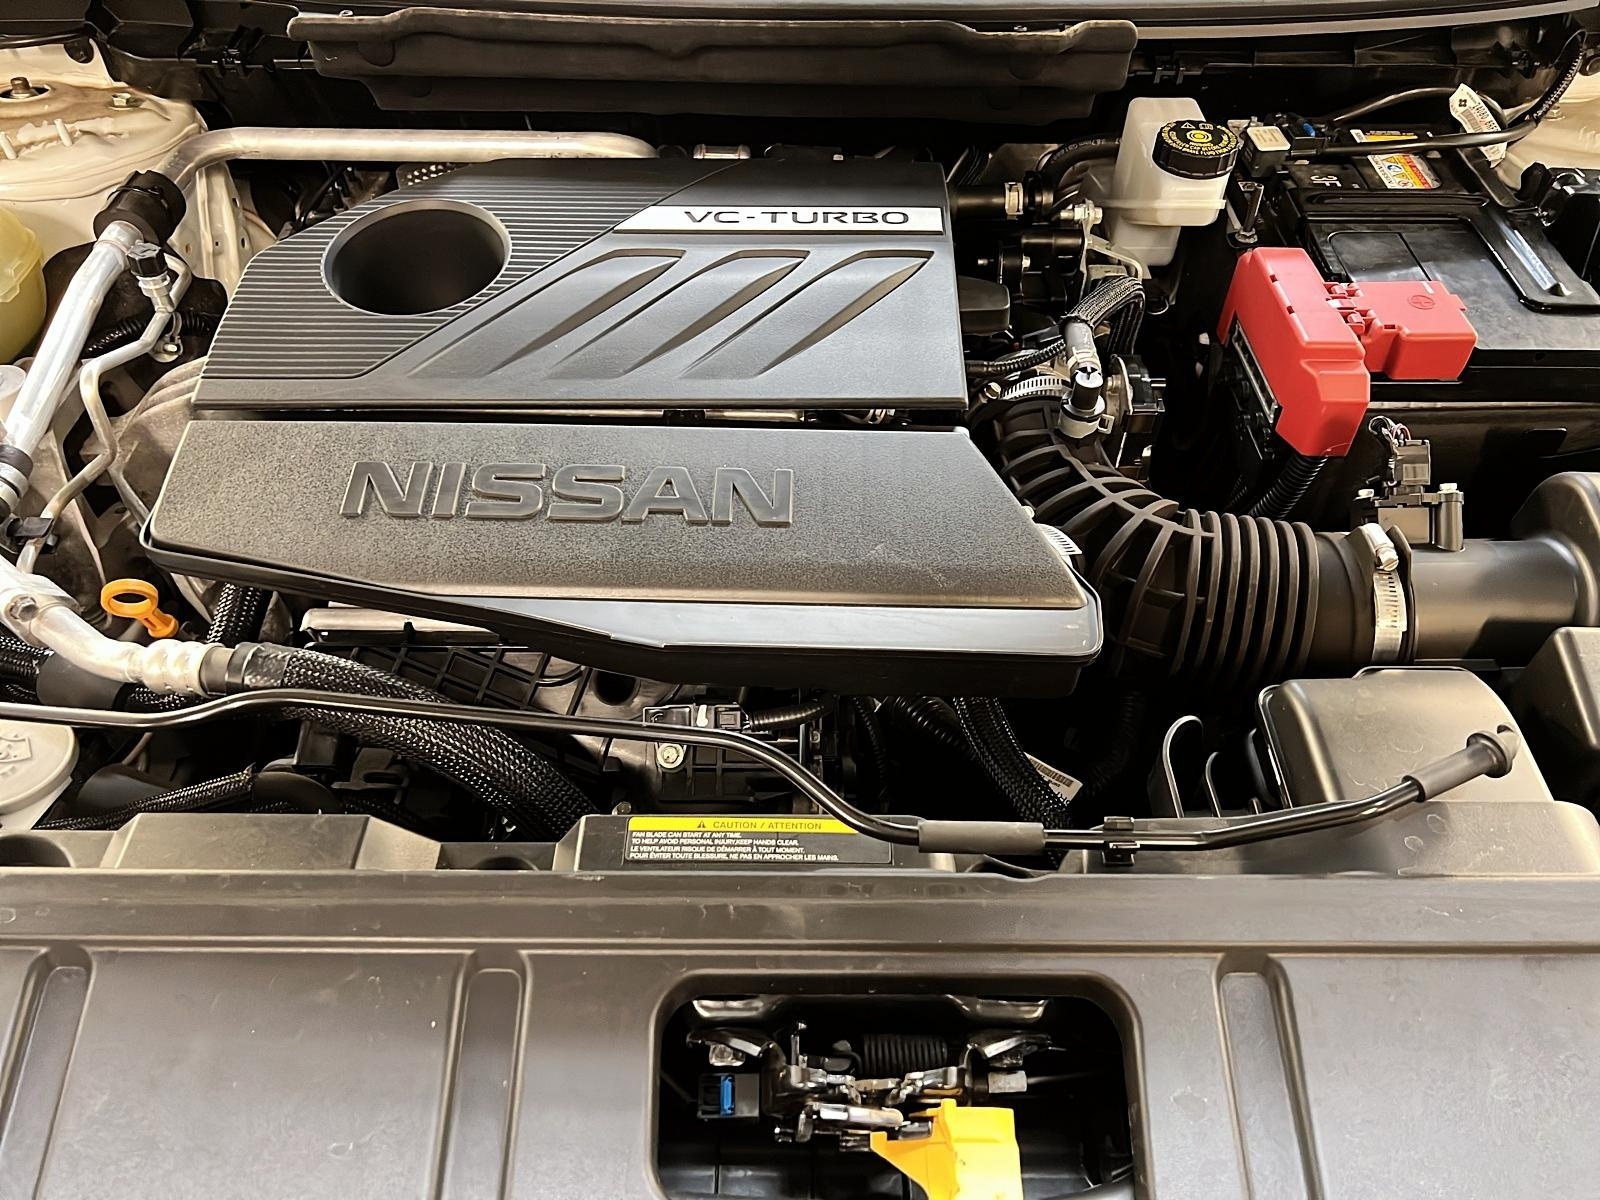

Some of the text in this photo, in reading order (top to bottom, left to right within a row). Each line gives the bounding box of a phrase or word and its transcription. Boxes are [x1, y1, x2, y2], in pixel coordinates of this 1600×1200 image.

[684, 211, 909, 224] VC-TURBO
[338, 461, 795, 528] NISSAN
[713, 821, 757, 829] CAUTION
[768, 822, 822, 830] ATTENTION
[716, 844, 752, 852] DÉMARRER
[650, 851, 671, 859] ÉVITER
